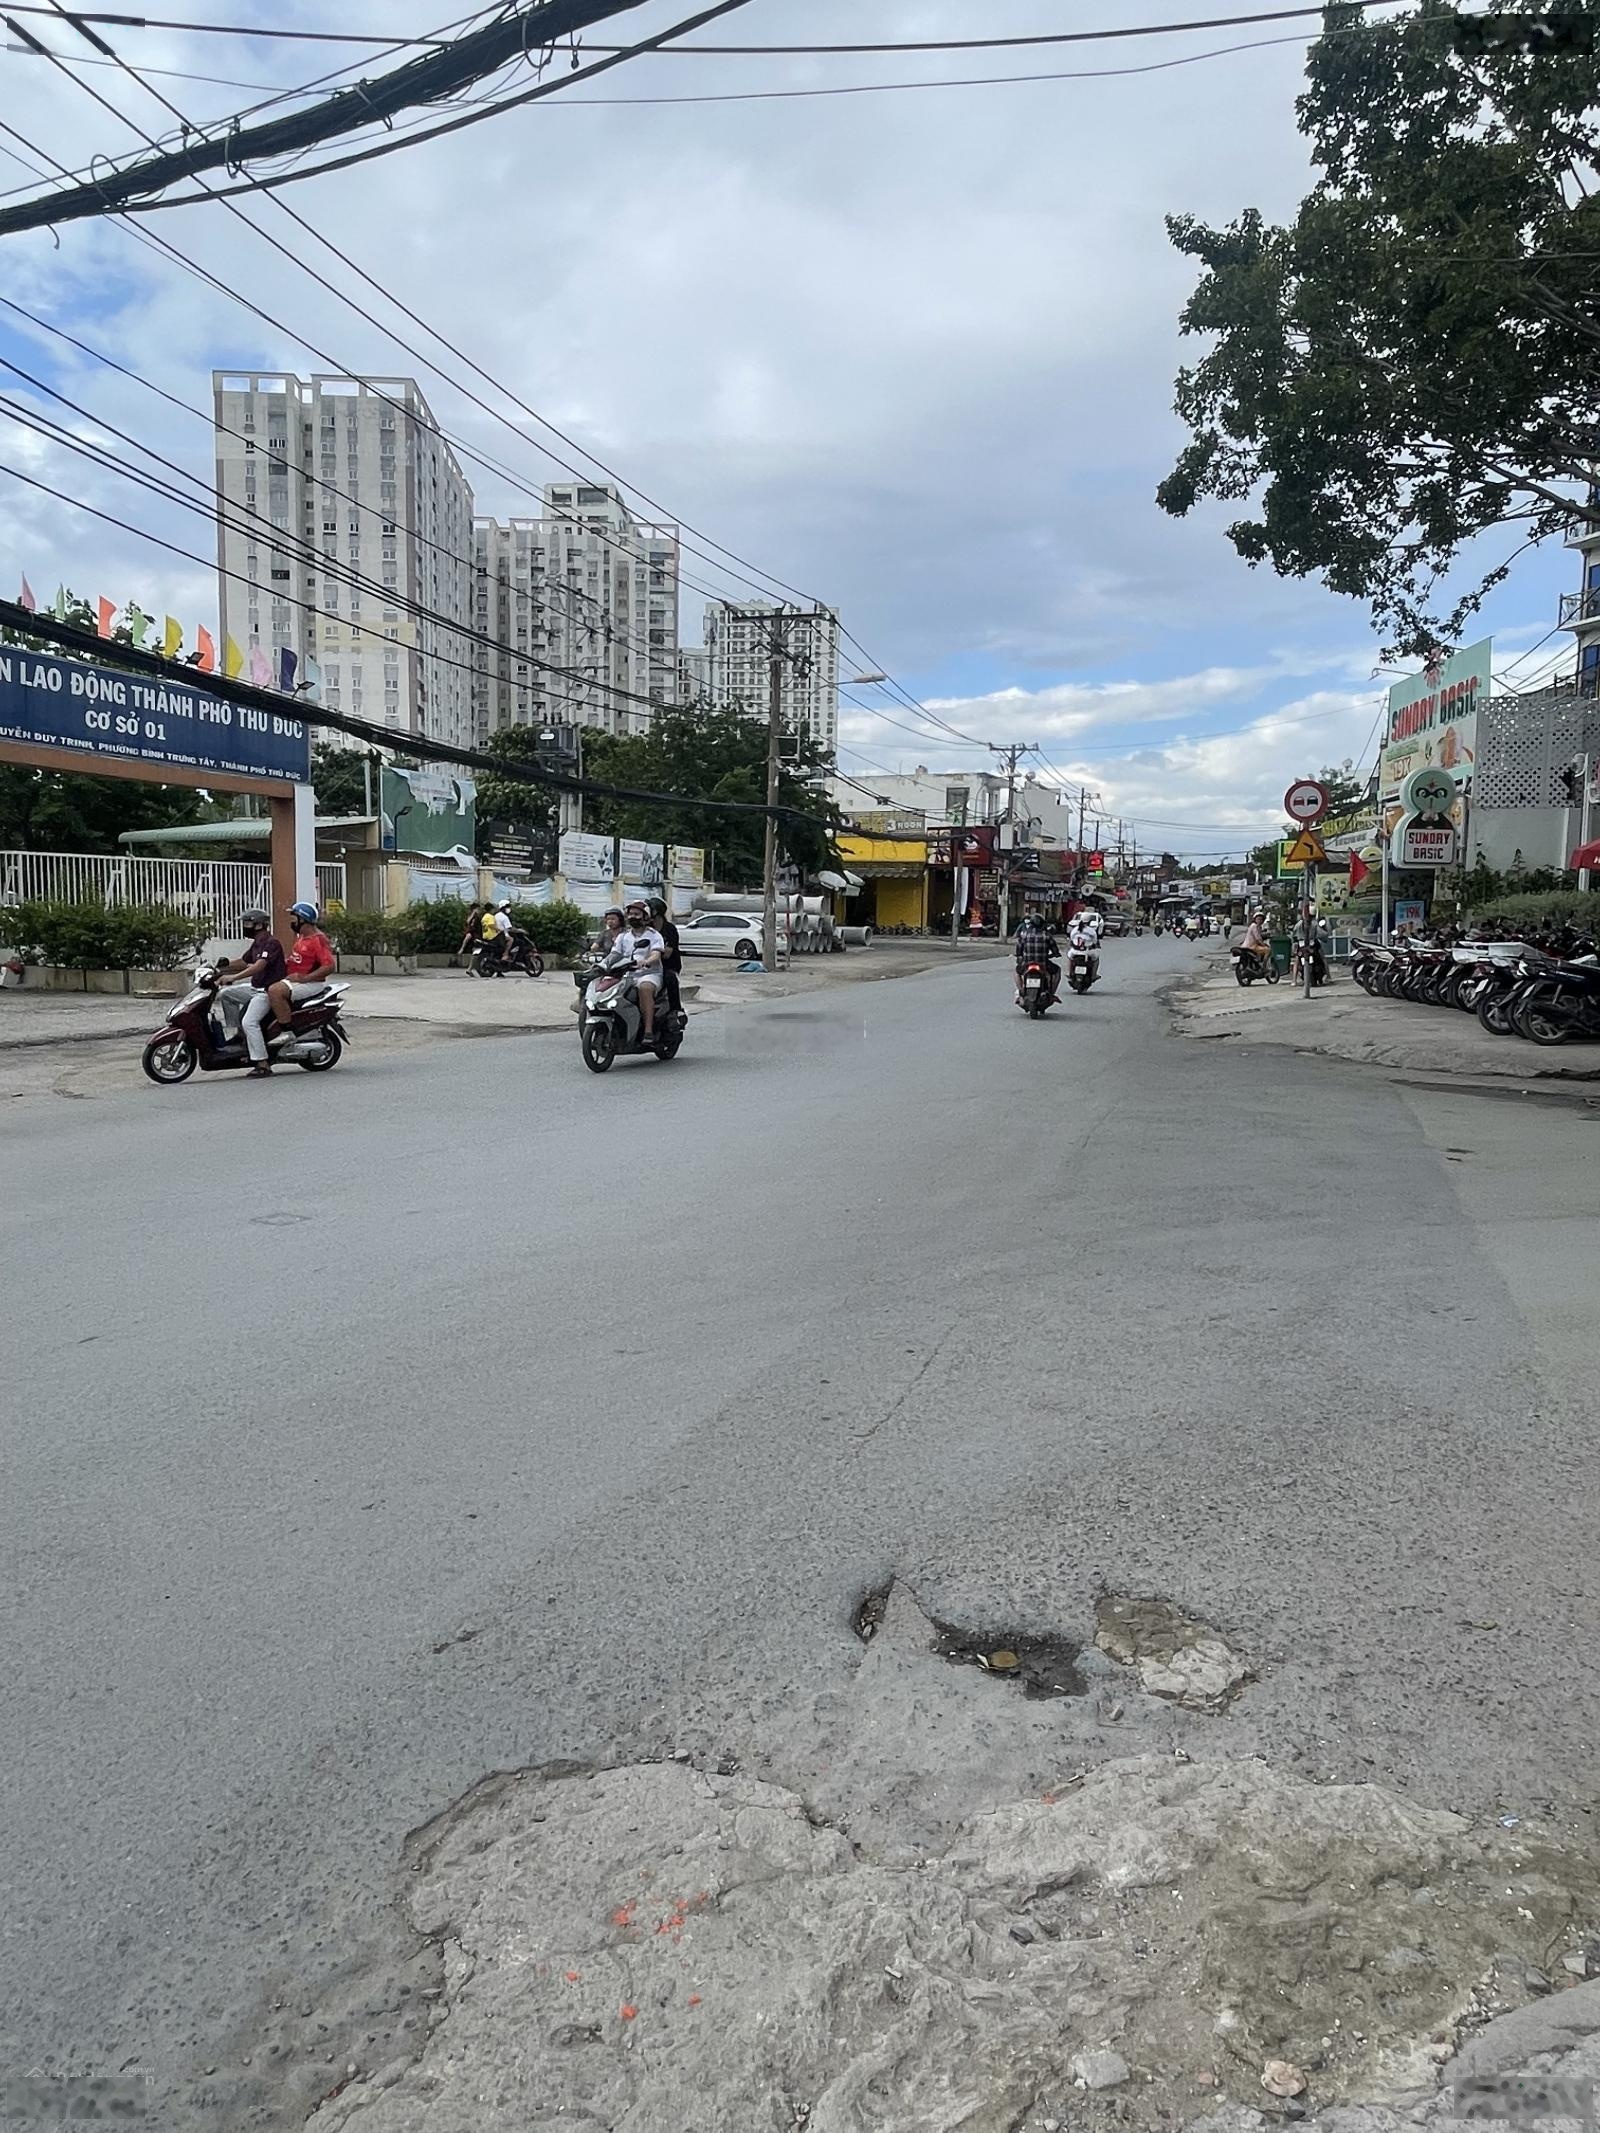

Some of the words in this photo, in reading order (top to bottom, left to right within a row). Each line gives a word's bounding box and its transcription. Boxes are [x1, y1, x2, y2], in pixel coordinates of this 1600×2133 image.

[19, 661, 63, 692] LAO
[70, 670, 126, 706] ĐỘNG
[130, 684, 193, 719] THÀNH
[85, 710, 112, 730] CƠ
[115, 711, 141, 735] SỞ
[145, 721, 167, 741] 01
[1391, 693, 1438, 742] SUNDAY
[34, 732, 57, 743] DUY
[1408, 832, 1450, 845] SUNDAY
